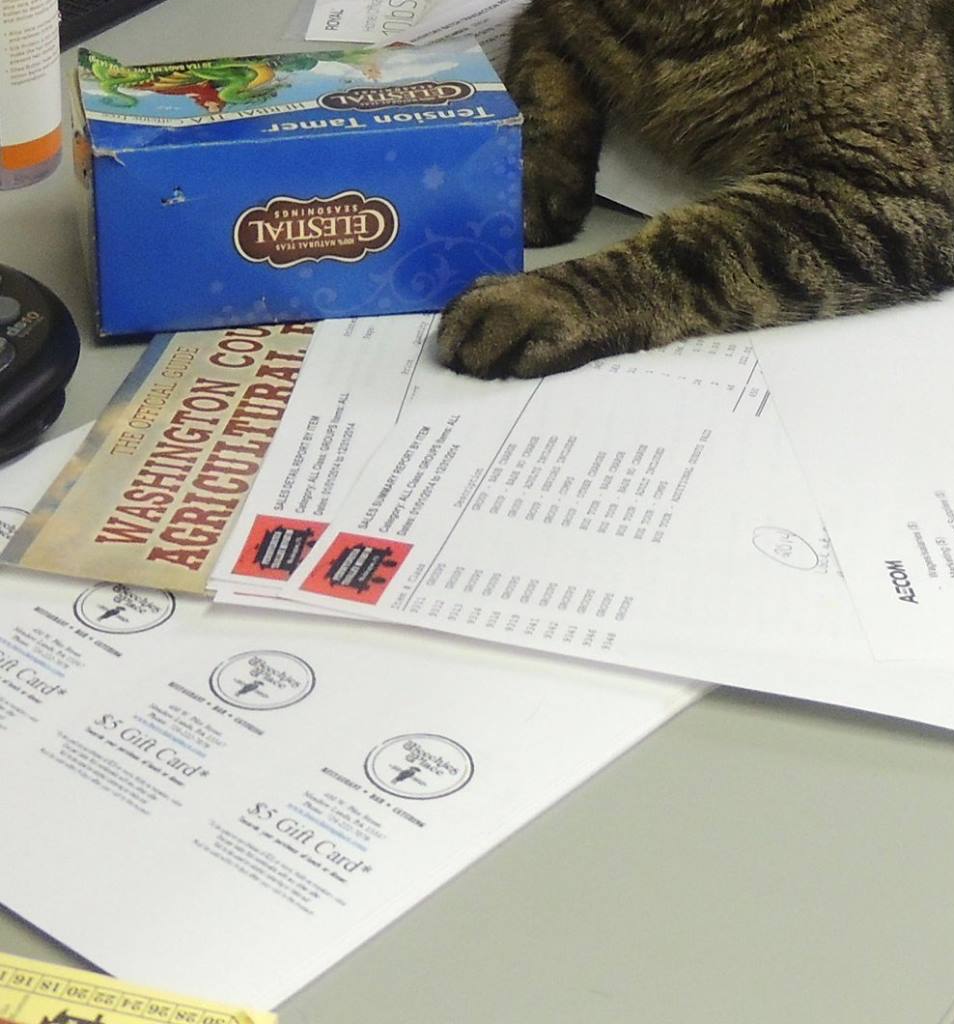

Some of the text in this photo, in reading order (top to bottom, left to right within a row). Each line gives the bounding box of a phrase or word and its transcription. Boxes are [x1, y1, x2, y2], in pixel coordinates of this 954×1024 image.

[327, 84, 464, 107] CELESTIAL
[268, 102, 497, 132] Tension Tamer
[248, 209, 385, 243] CELESTIAL
[274, 204, 358, 219] SEASONINGS
[275, 238, 355, 251] 100% NATURAL TEAS
[110, 346, 199, 456] THE OFFICIAL GUIDE
[308, 470, 321, 483] ALL
[320, 424, 338, 451] GROUPS
[338, 392, 350, 403] ALL
[399, 488, 415, 501] ALL
[419, 443, 443, 470] GROUPS
[448, 414, 461, 425] ALL
[94, 377, 242, 544] WASHINGTON
[146, 349, 306, 572] AGRICULTURAL
[274, 415, 320, 511] SALES DETAIL REPORT BY ITEM
[357, 425, 431, 530] SALES SUMMARY REPORT BY ITEM
[94, 713, 120, 732] $5
[120, 726, 157, 754] Gift
[247, 801, 278, 821] $5
[276, 816, 315, 845] Gift
[13, 974, 33, 987] 16
[40, 979, 60, 993] 18
[66, 985, 89, 999] 20
